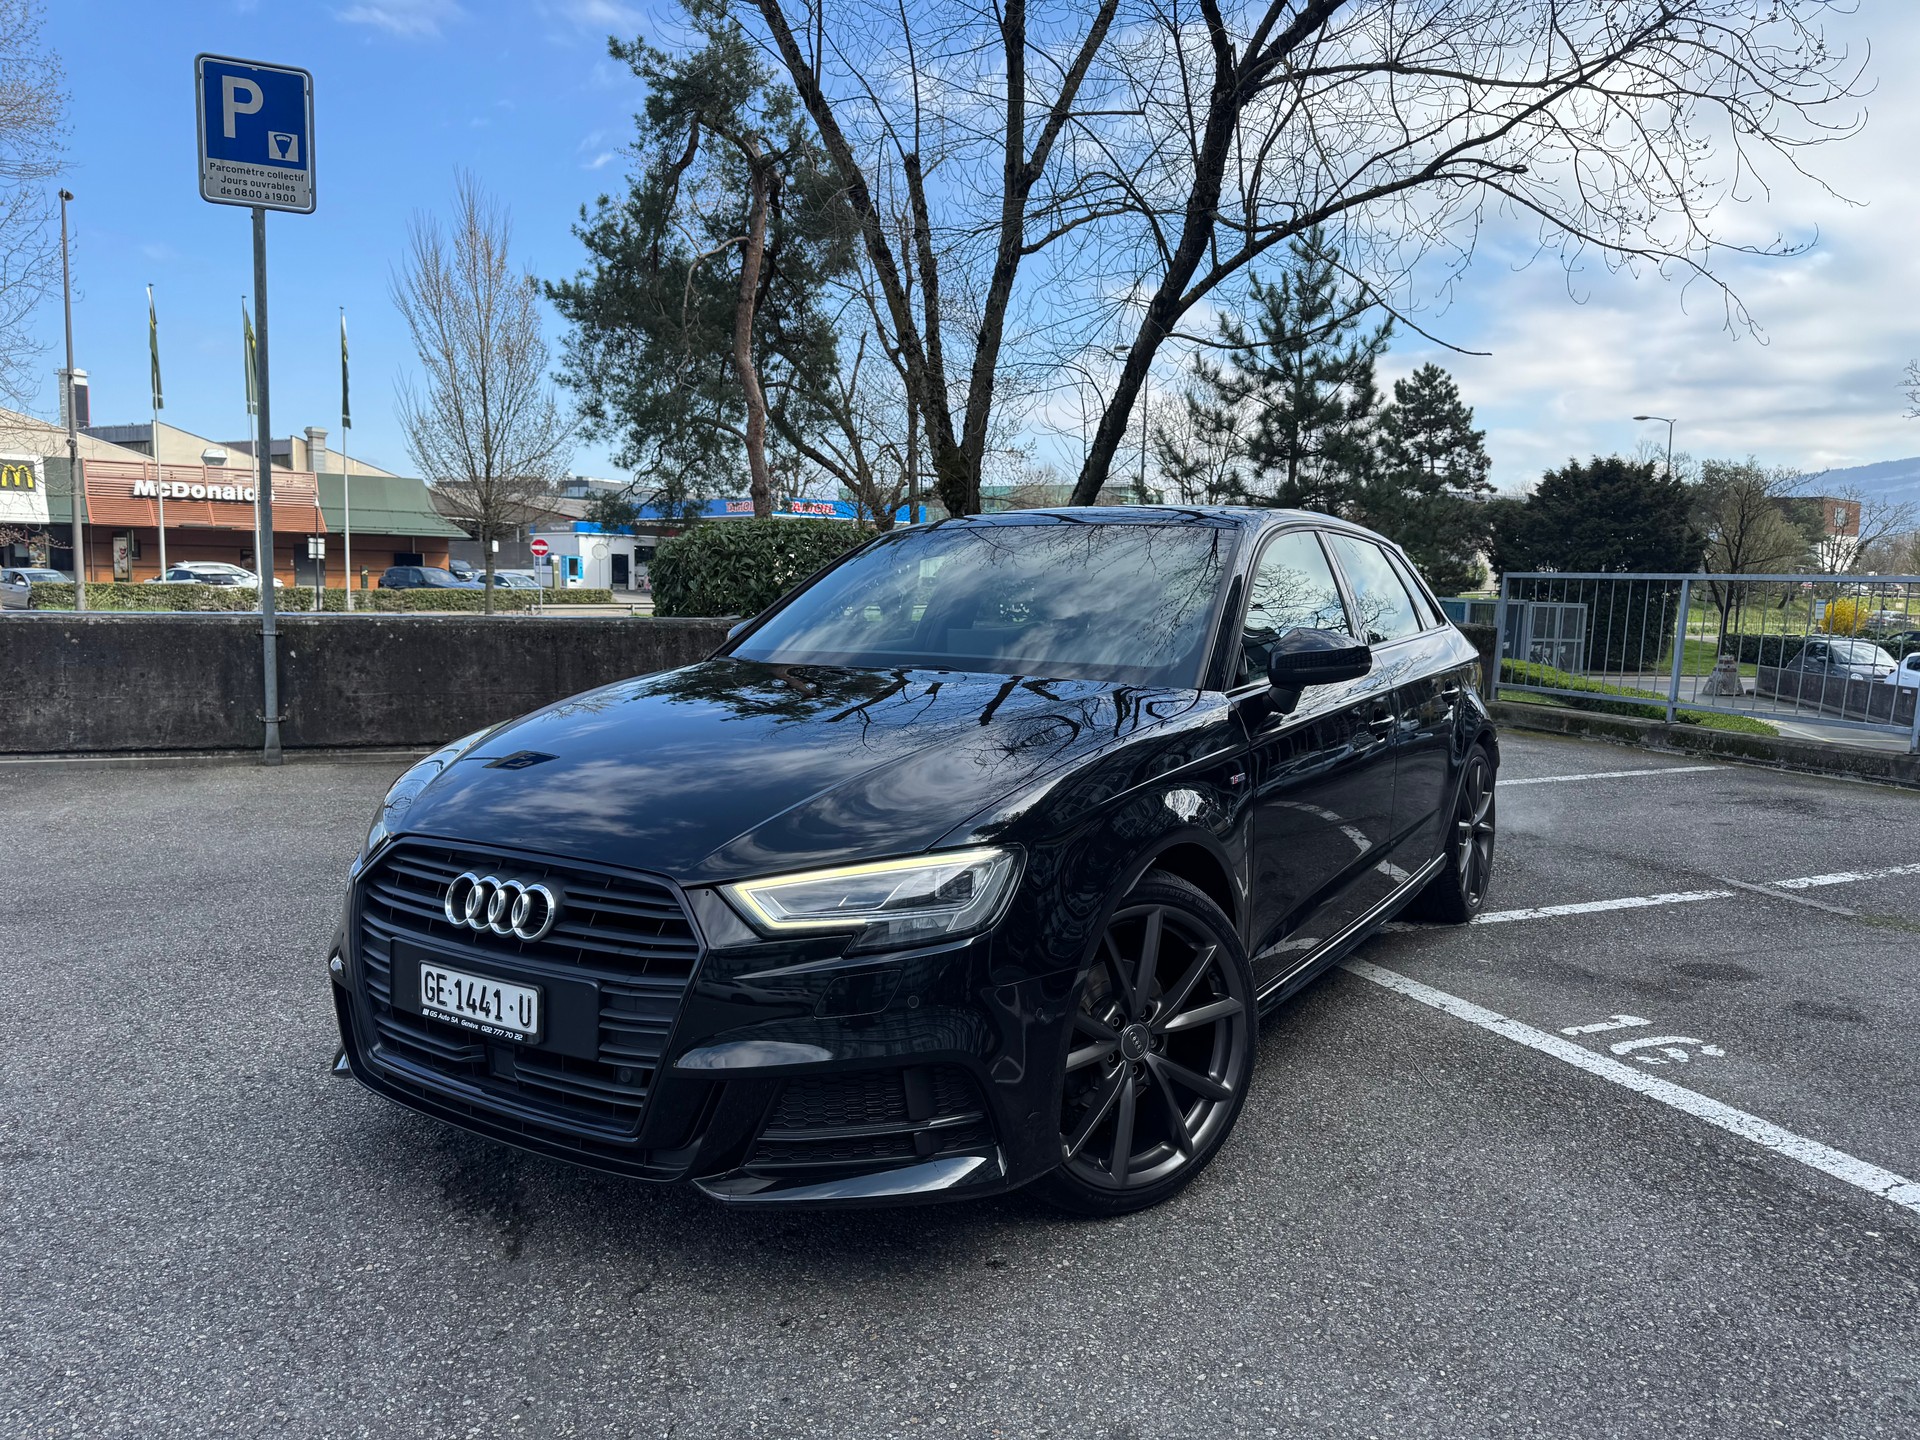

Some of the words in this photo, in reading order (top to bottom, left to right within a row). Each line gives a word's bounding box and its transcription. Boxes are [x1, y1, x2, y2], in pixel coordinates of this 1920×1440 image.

[222, 75, 264, 138] P
[209, 162, 265, 177] Parcomètre
[267, 171, 304, 182] collectif
[220, 175, 248, 186] Jours
[250, 180, 296, 191] ouvrables
[220, 186, 232, 195] de
[264, 192, 270, 200] à
[272, 193, 296, 203] 19.00
[133, 480, 275, 501] McDonald
[726, 501, 755, 512] TAMOI
[429, 1010, 438, 1019] GS
[438, 1013, 450, 1022] Auto
[481, 1024, 493, 1034] 022
[493, 1028, 505, 1037] 777
[504, 1031, 514, 1040] 70
[514, 1033, 524, 1041] 22
